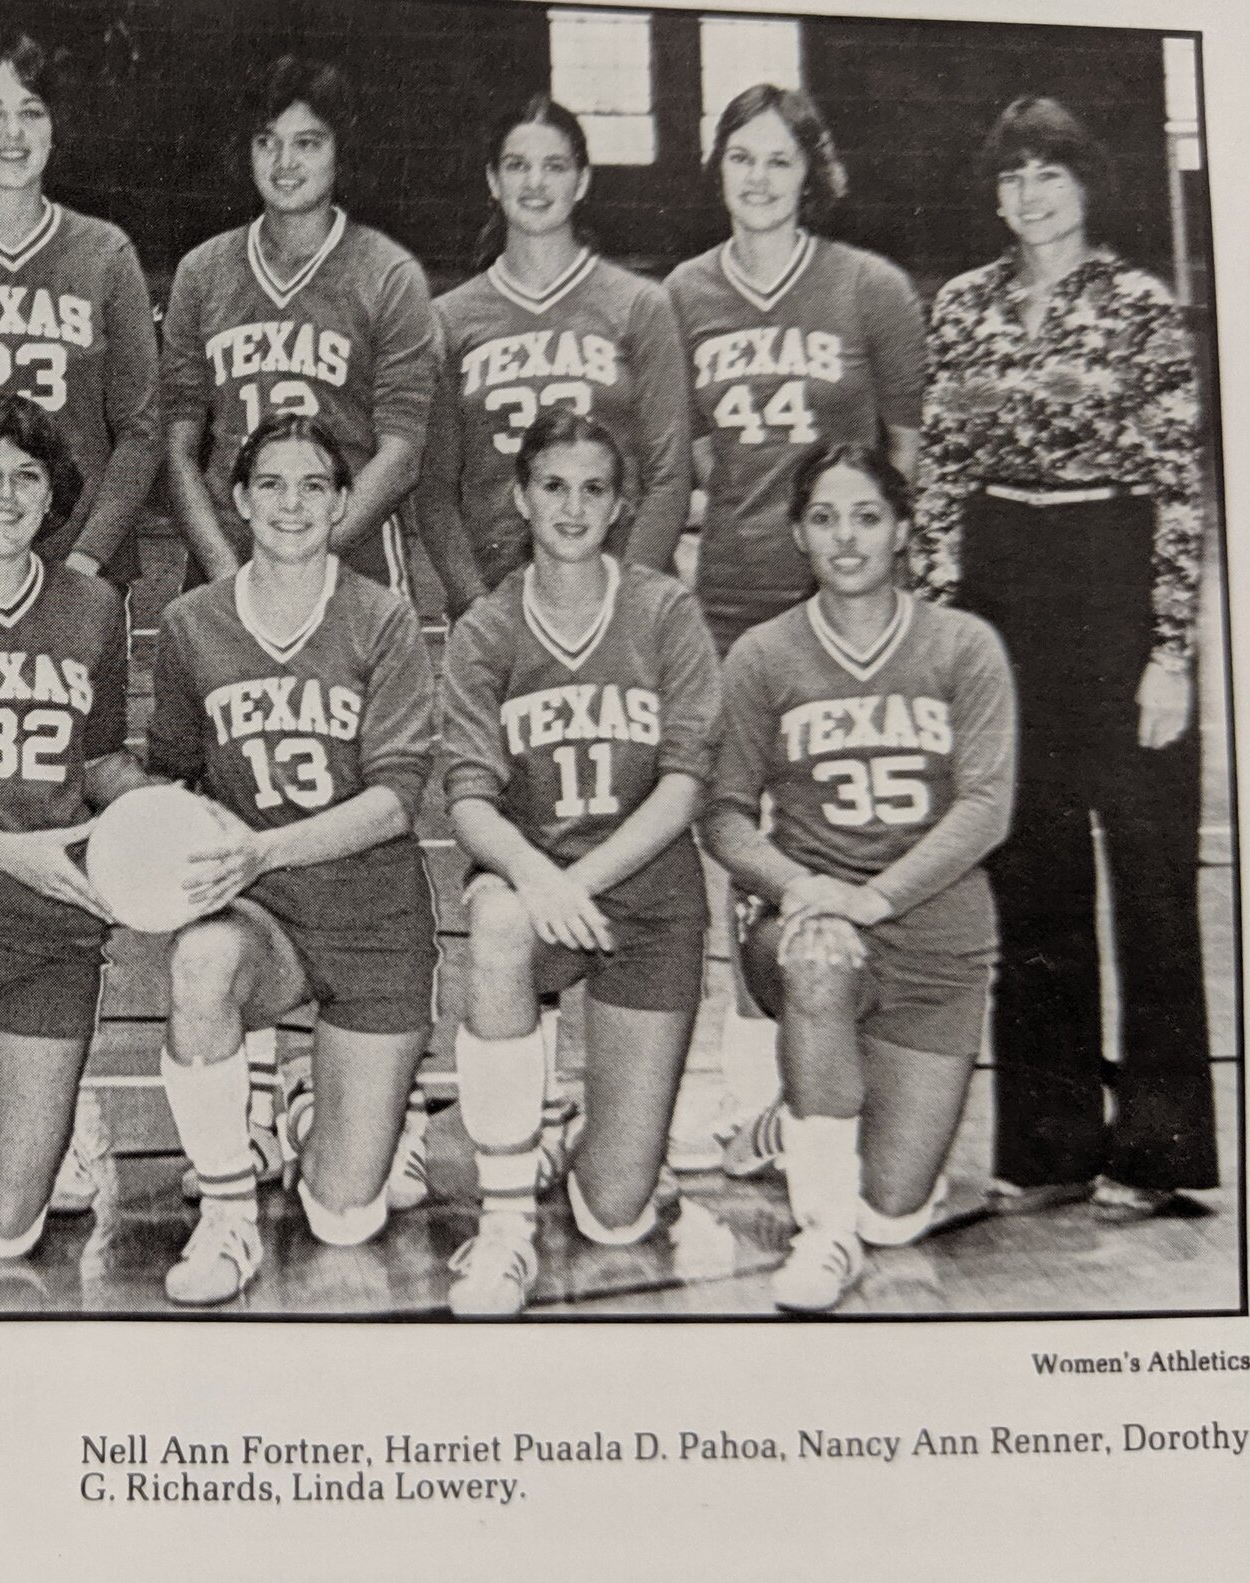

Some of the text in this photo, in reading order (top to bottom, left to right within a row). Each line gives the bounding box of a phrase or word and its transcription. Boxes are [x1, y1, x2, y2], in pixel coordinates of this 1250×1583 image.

[204, 320, 352, 388] TEXAS
[458, 328, 619, 397] TEXAS
[690, 325, 844, 390] TEXAS
[713, 380, 819, 445] 44
[203, 675, 364, 746] TEXAS
[498, 683, 663, 757] TEXAS
[778, 693, 954, 763] TEXAS
[241, 737, 335, 809] 13
[551, 742, 619, 818] 11
[811, 754, 932, 827] 35
[1032, 1350, 1250, 1374] Women's Athletics
[82, 1421, 1249, 1467] Nell Ann Fortner, Harriet Puaala D. Pahoa, Nancy Ann Renner, Dorothy
[80, 1471, 525, 1505] G. Richards, Linda Lowery.
